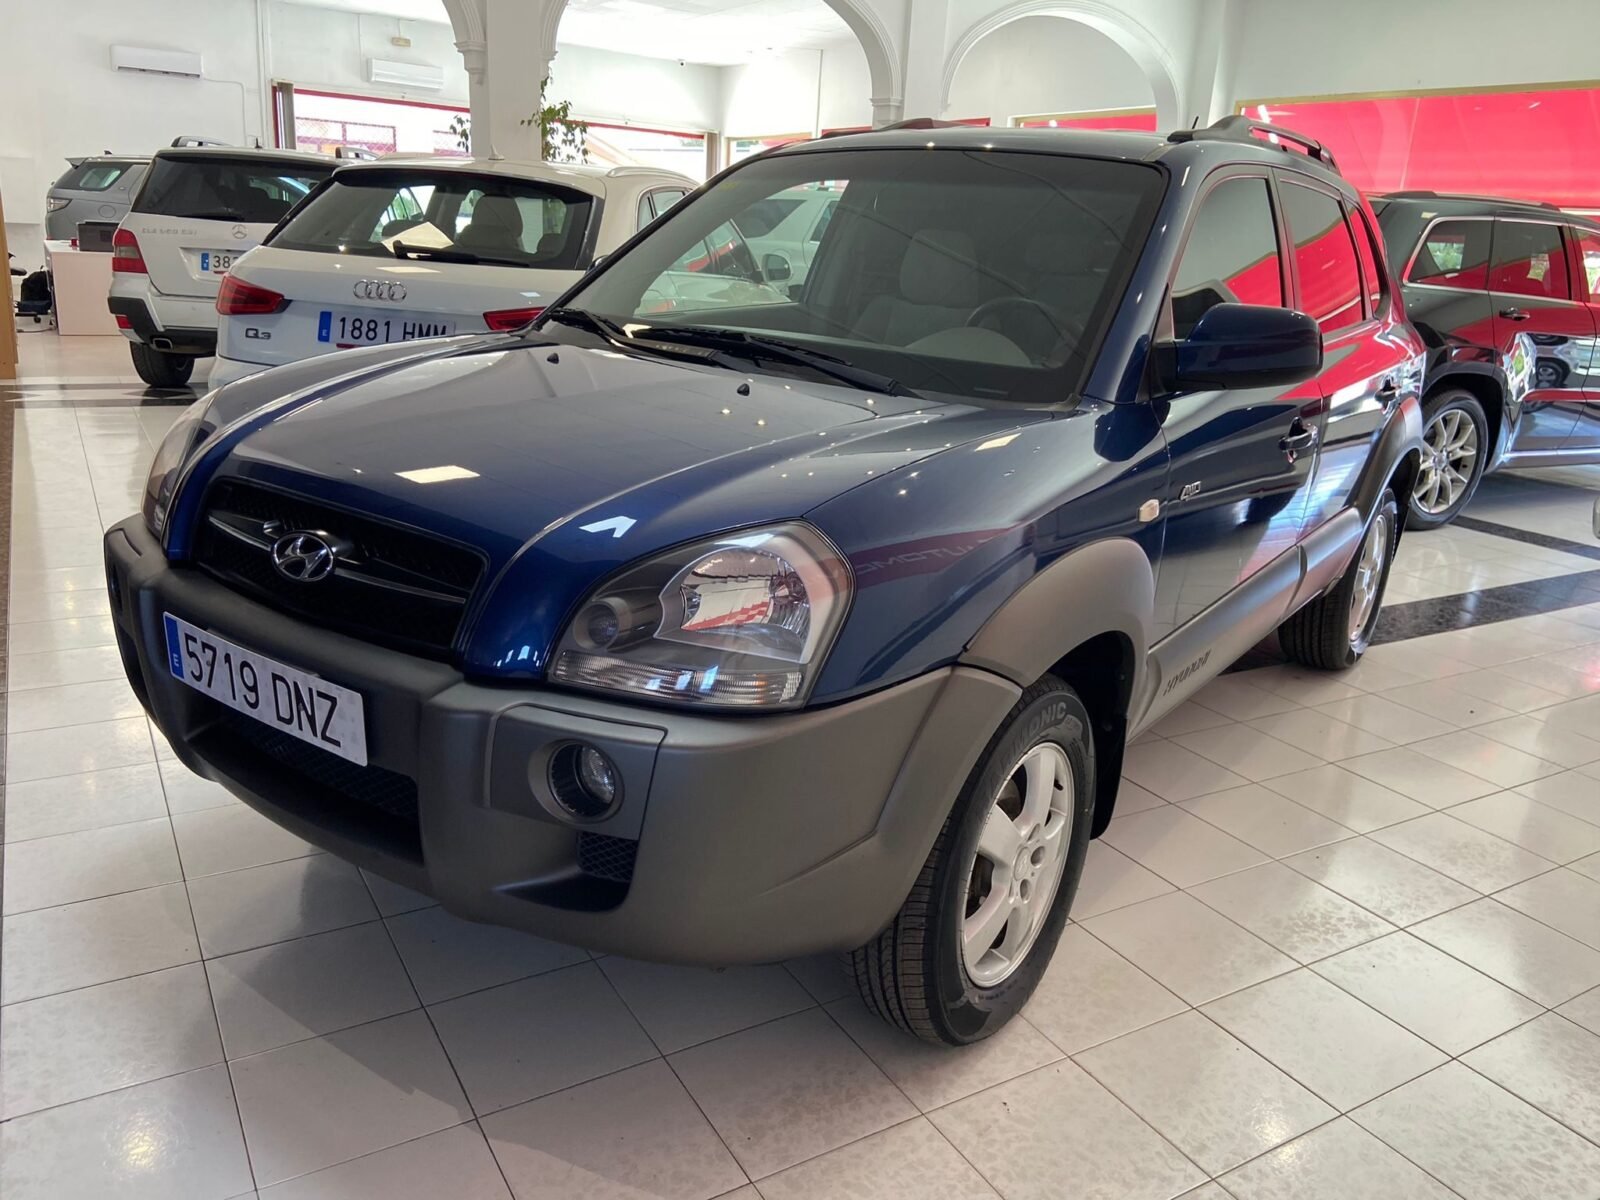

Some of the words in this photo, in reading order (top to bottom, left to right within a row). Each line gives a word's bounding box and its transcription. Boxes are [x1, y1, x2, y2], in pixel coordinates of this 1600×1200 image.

[245, 327, 272, 340] Q3
[339, 316, 391, 343] 1881
[402, 321, 447, 341] HMM
[173, 653, 180, 667] E
[184, 632, 260, 710] 5719
[271, 672, 341, 748] DNZ
